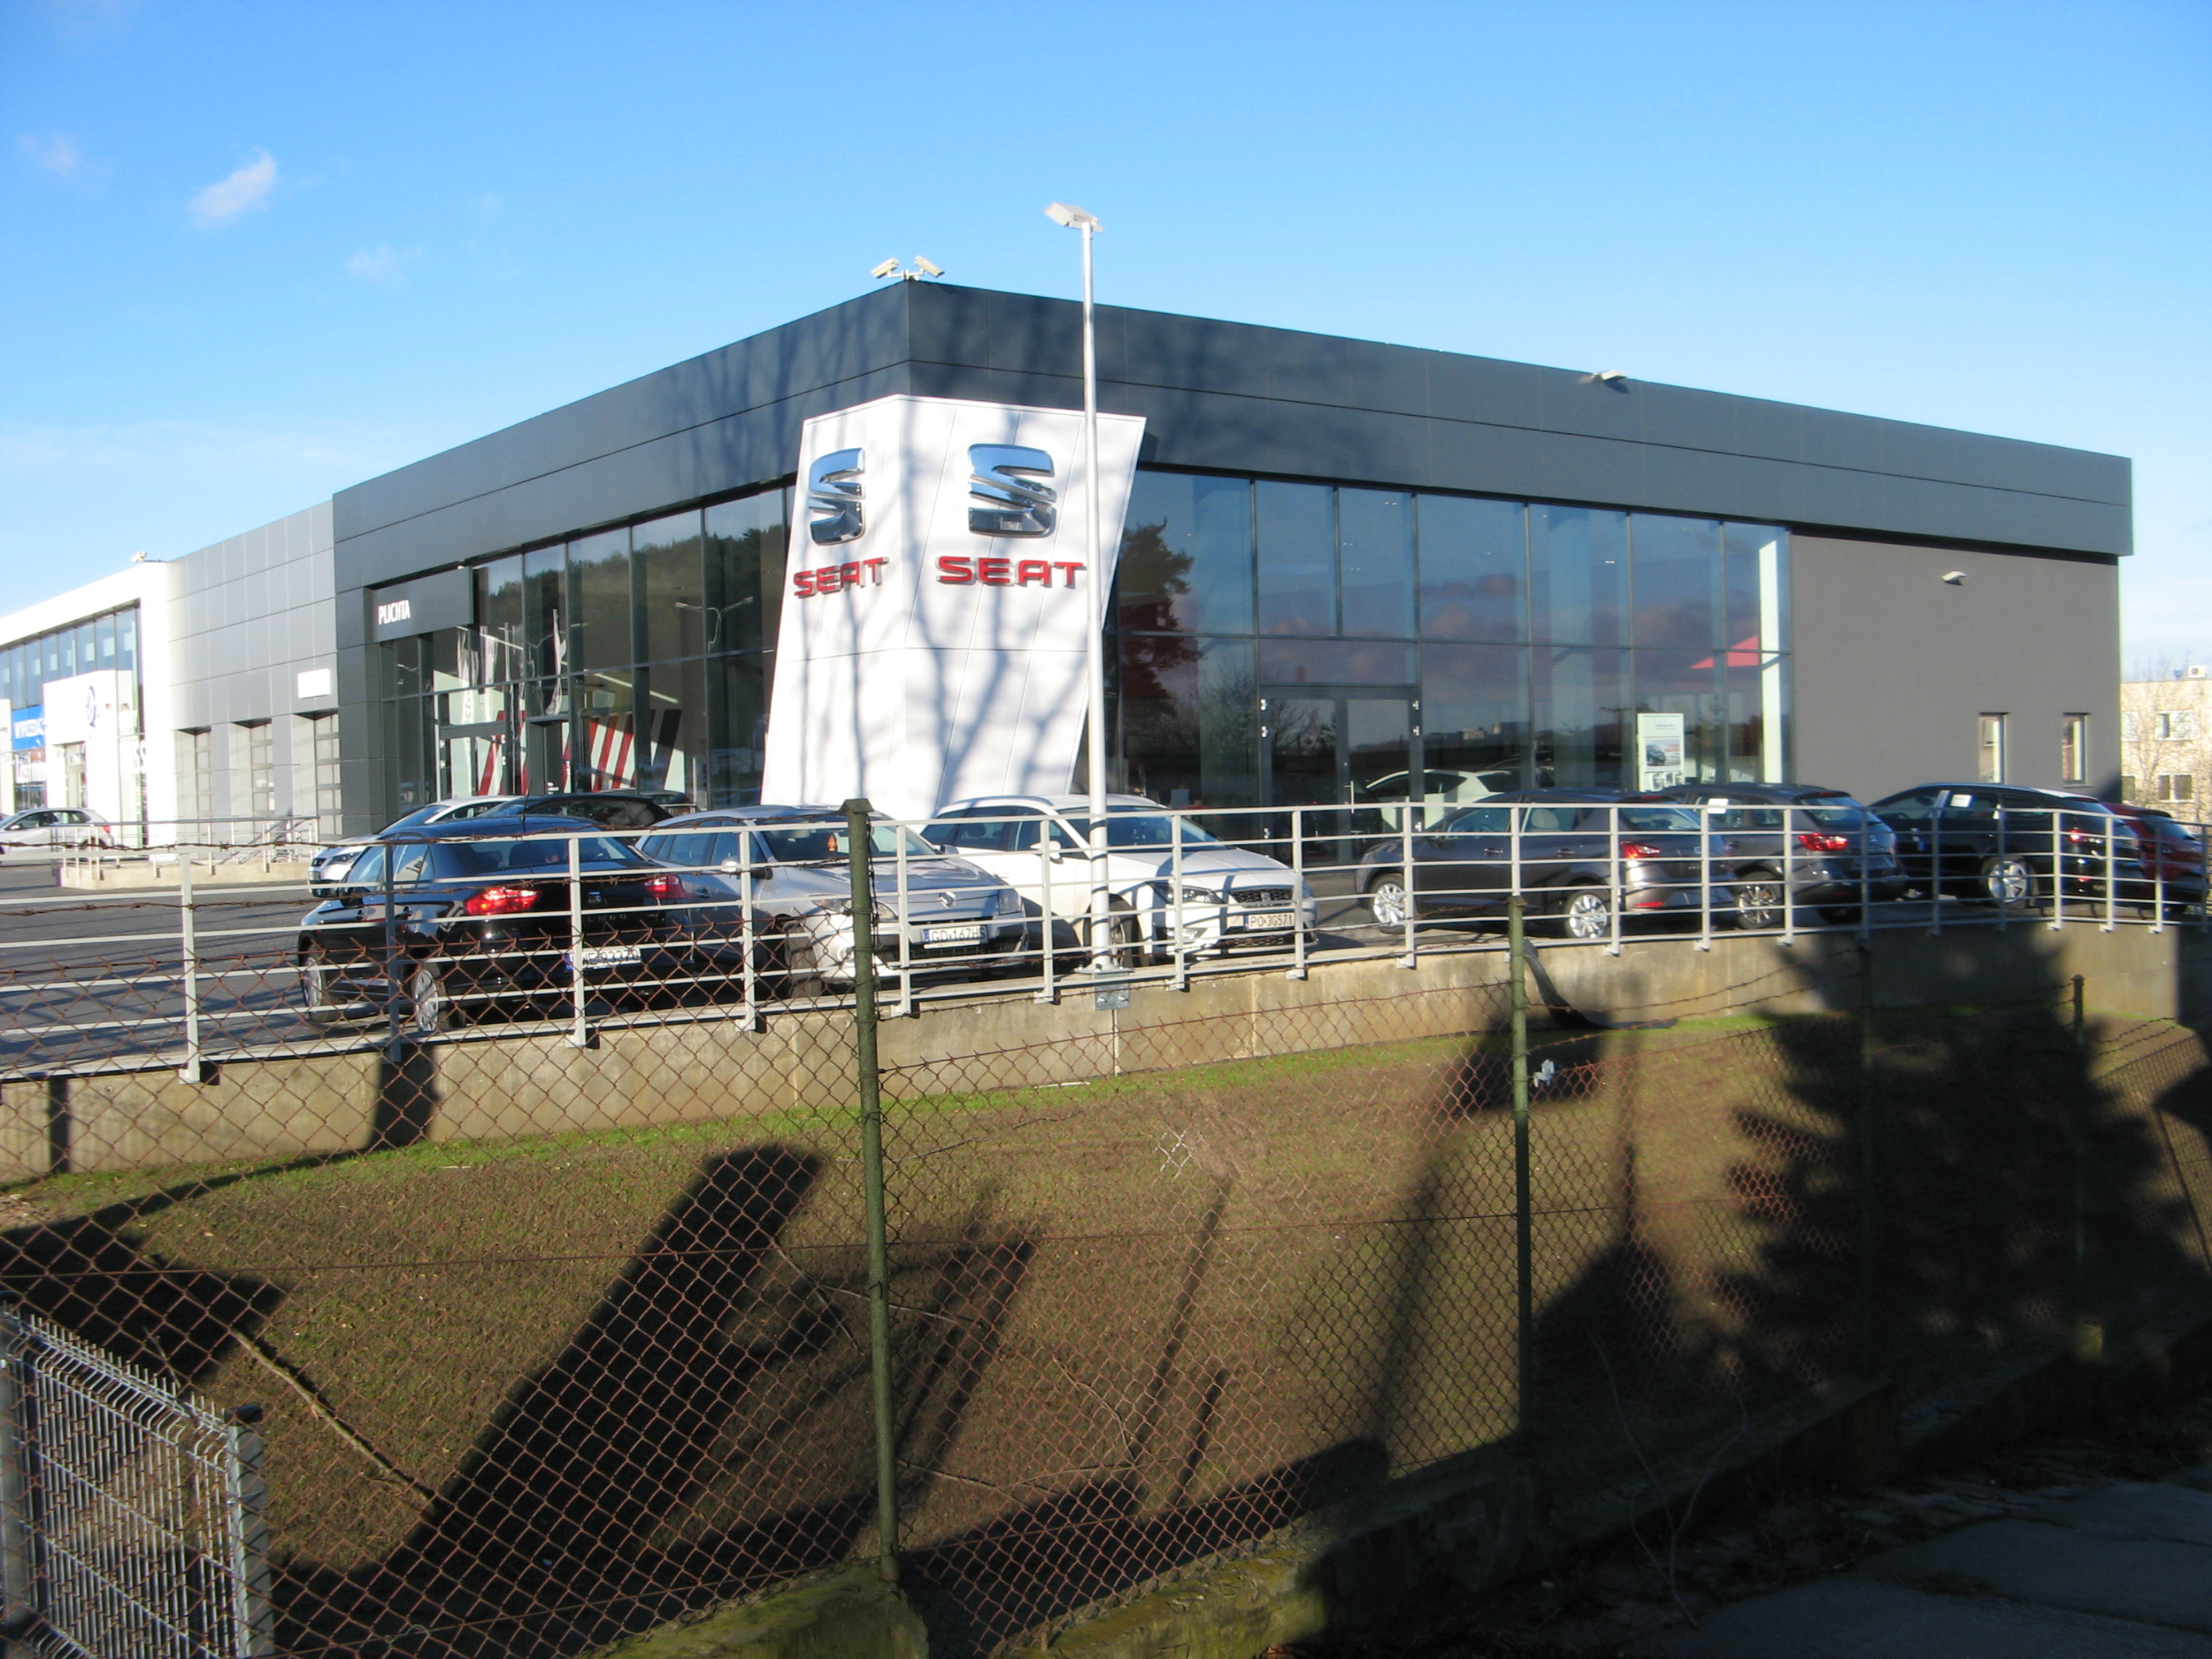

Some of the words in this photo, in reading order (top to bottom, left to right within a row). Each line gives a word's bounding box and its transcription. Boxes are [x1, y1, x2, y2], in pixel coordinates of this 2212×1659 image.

[793, 556, 889, 597] SEAT
[937, 556, 1086, 588] SEAT
[377, 599, 410, 625] PLICHTA
